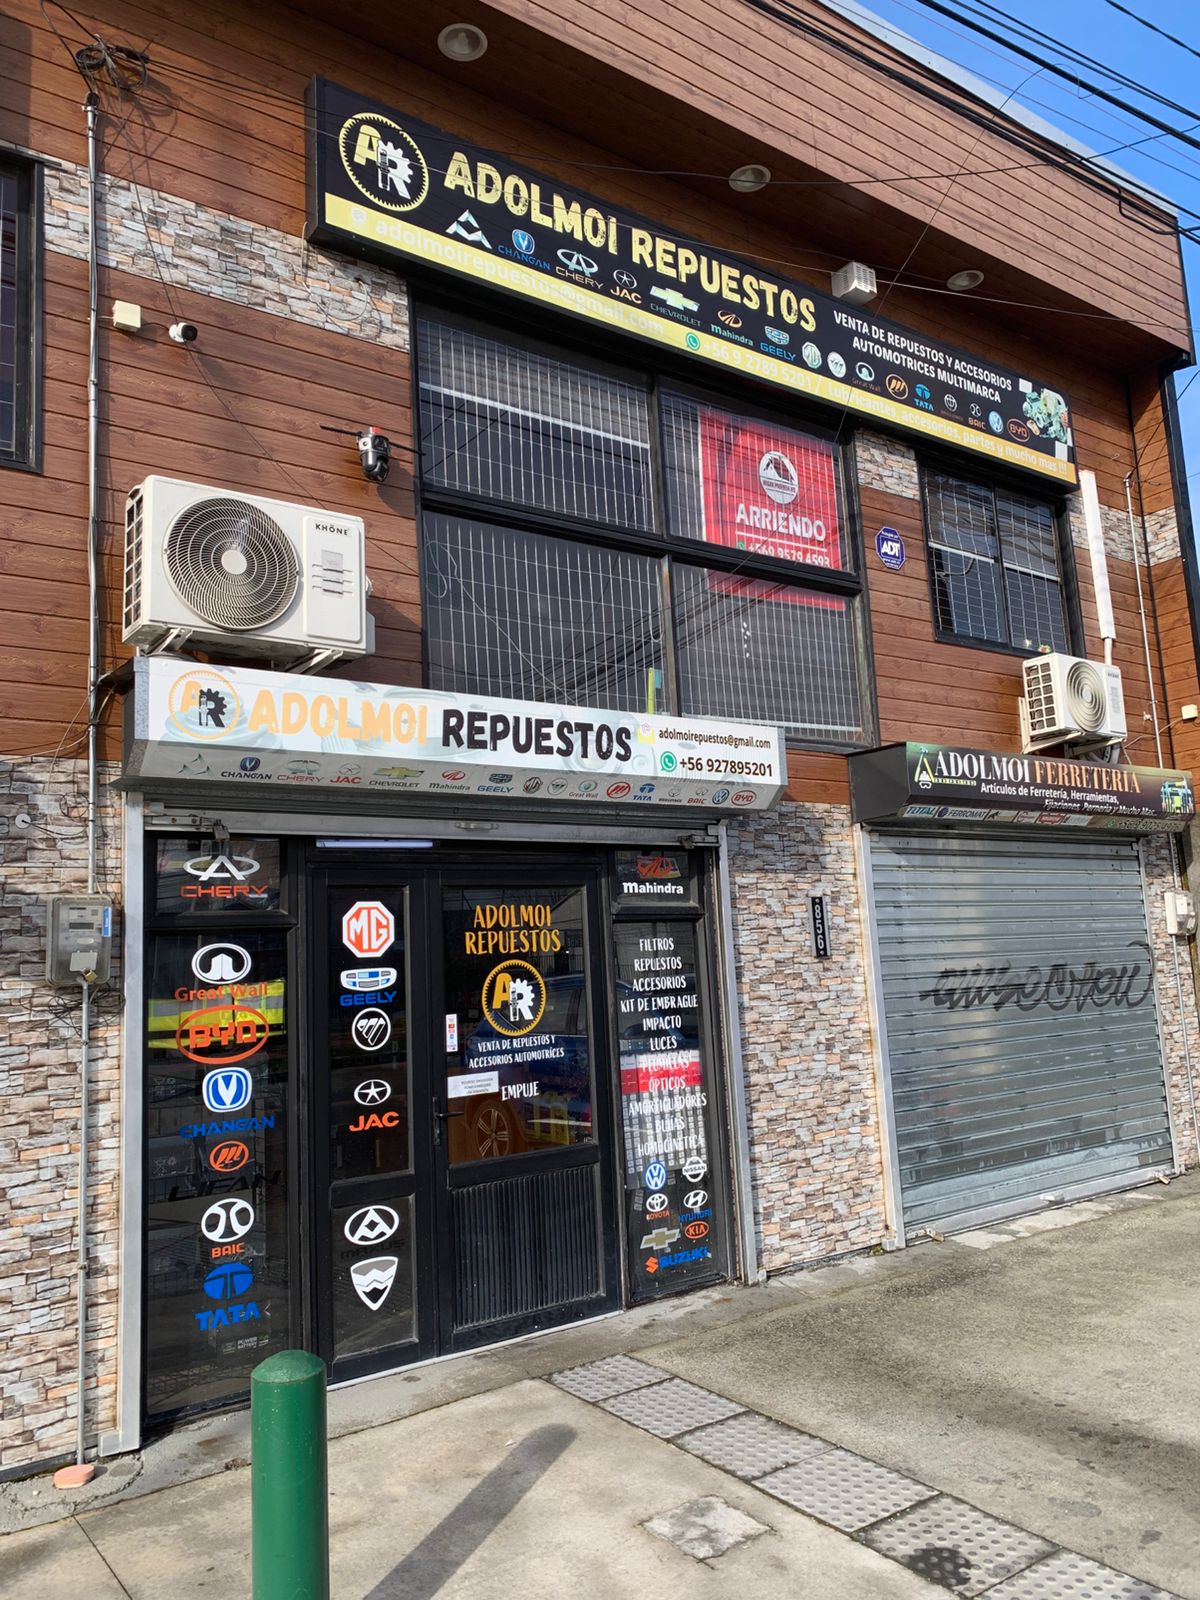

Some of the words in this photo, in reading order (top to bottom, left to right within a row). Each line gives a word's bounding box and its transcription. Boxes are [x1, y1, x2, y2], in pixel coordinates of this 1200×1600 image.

[444, 152, 618, 255] ADOLMOI
[632, 227, 816, 332] REPUESTOS
[498, 244, 550, 270] CHANGAN
[555, 266, 604, 290] CHERY
[610, 287, 642, 304] JAC
[650, 303, 701, 327] CHEVROLET
[760, 342, 796, 362] GEELY
[834, 310, 870, 335] VENTA
[872, 325, 885, 342] DE
[887, 332, 944, 364] REPUESTOS
[945, 355, 952, 367] Y
[954, 361, 1012, 391] ACCESORIOS
[853, 336, 935, 378] AUTOMOTRICES
[937, 369, 1001, 403] MULTIMARCA
[914, 399, 934, 412] TATA
[968, 417, 986, 430] BAIC
[1009, 425, 1028, 438] BYD
[736, 503, 826, 542] ARRIENDO
[881, 540, 900, 557] ADT
[247, 689, 427, 746] ADOLMOI
[442, 708, 632, 762] REPUESTOS
[659, 728, 771, 749] adolmoirepuestos@gmail.com
[221, 771, 272, 780] CHANGAN
[680, 757, 703, 772] +56
[707, 758, 773, 777] 927895201
[934, 751, 1030, 783] ADOLMOI
[1034, 760, 1141, 793] FERRETERIA
[277, 774, 325, 783] CHERY
[330, 776, 362, 784] JAC
[369, 780, 420, 788] CHEVROLET
[477, 785, 514, 793] GEELY
[734, 794, 753, 802] BYD
[981, 782, 1016, 796] Artículos
[1018, 785, 1028, 796] de
[180, 884, 268, 898] CHERY
[473, 904, 551, 928] ADOLMOI
[350, 908, 389, 950] MG
[814, 904, 825, 949] 856
[465, 929, 561, 954] REPUESTOS
[640, 937, 674, 952] FILTROS
[634, 956, 682, 972] REPUESTOS
[175, 986, 225, 1001] Great
[228, 982, 268, 999] Wall
[632, 975, 686, 991] ACCESORIOS
[340, 991, 398, 1006] GEELY
[621, 998, 634, 1013] KIT
[637, 997, 649, 1012] DE
[652, 994, 698, 1011] EMBRAGUE
[643, 1015, 681, 1031] IMPACTO
[189, 1020, 257, 1048] BYD
[478, 1040, 500, 1053] VENTA
[502, 1038, 511, 1050] DE
[513, 1035, 550, 1048] REPUESTOS
[551, 1034, 555, 1044] Y
[650, 1035, 677, 1051] LUCES
[469, 1054, 513, 1069] ACCESORIOS
[501, 1081, 539, 1101] EMPUJE
[178, 1115, 276, 1139] CHANGAN
[349, 1111, 400, 1132] JAC
[684, 1165, 706, 1174] NISSAN
[646, 1210, 670, 1220] TOYOTA
[688, 1224, 706, 1236] KIA
[211, 1242, 245, 1259] BAIC
[660, 1247, 710, 1269] SUZUKI
[194, 1301, 261, 1331] TATA
